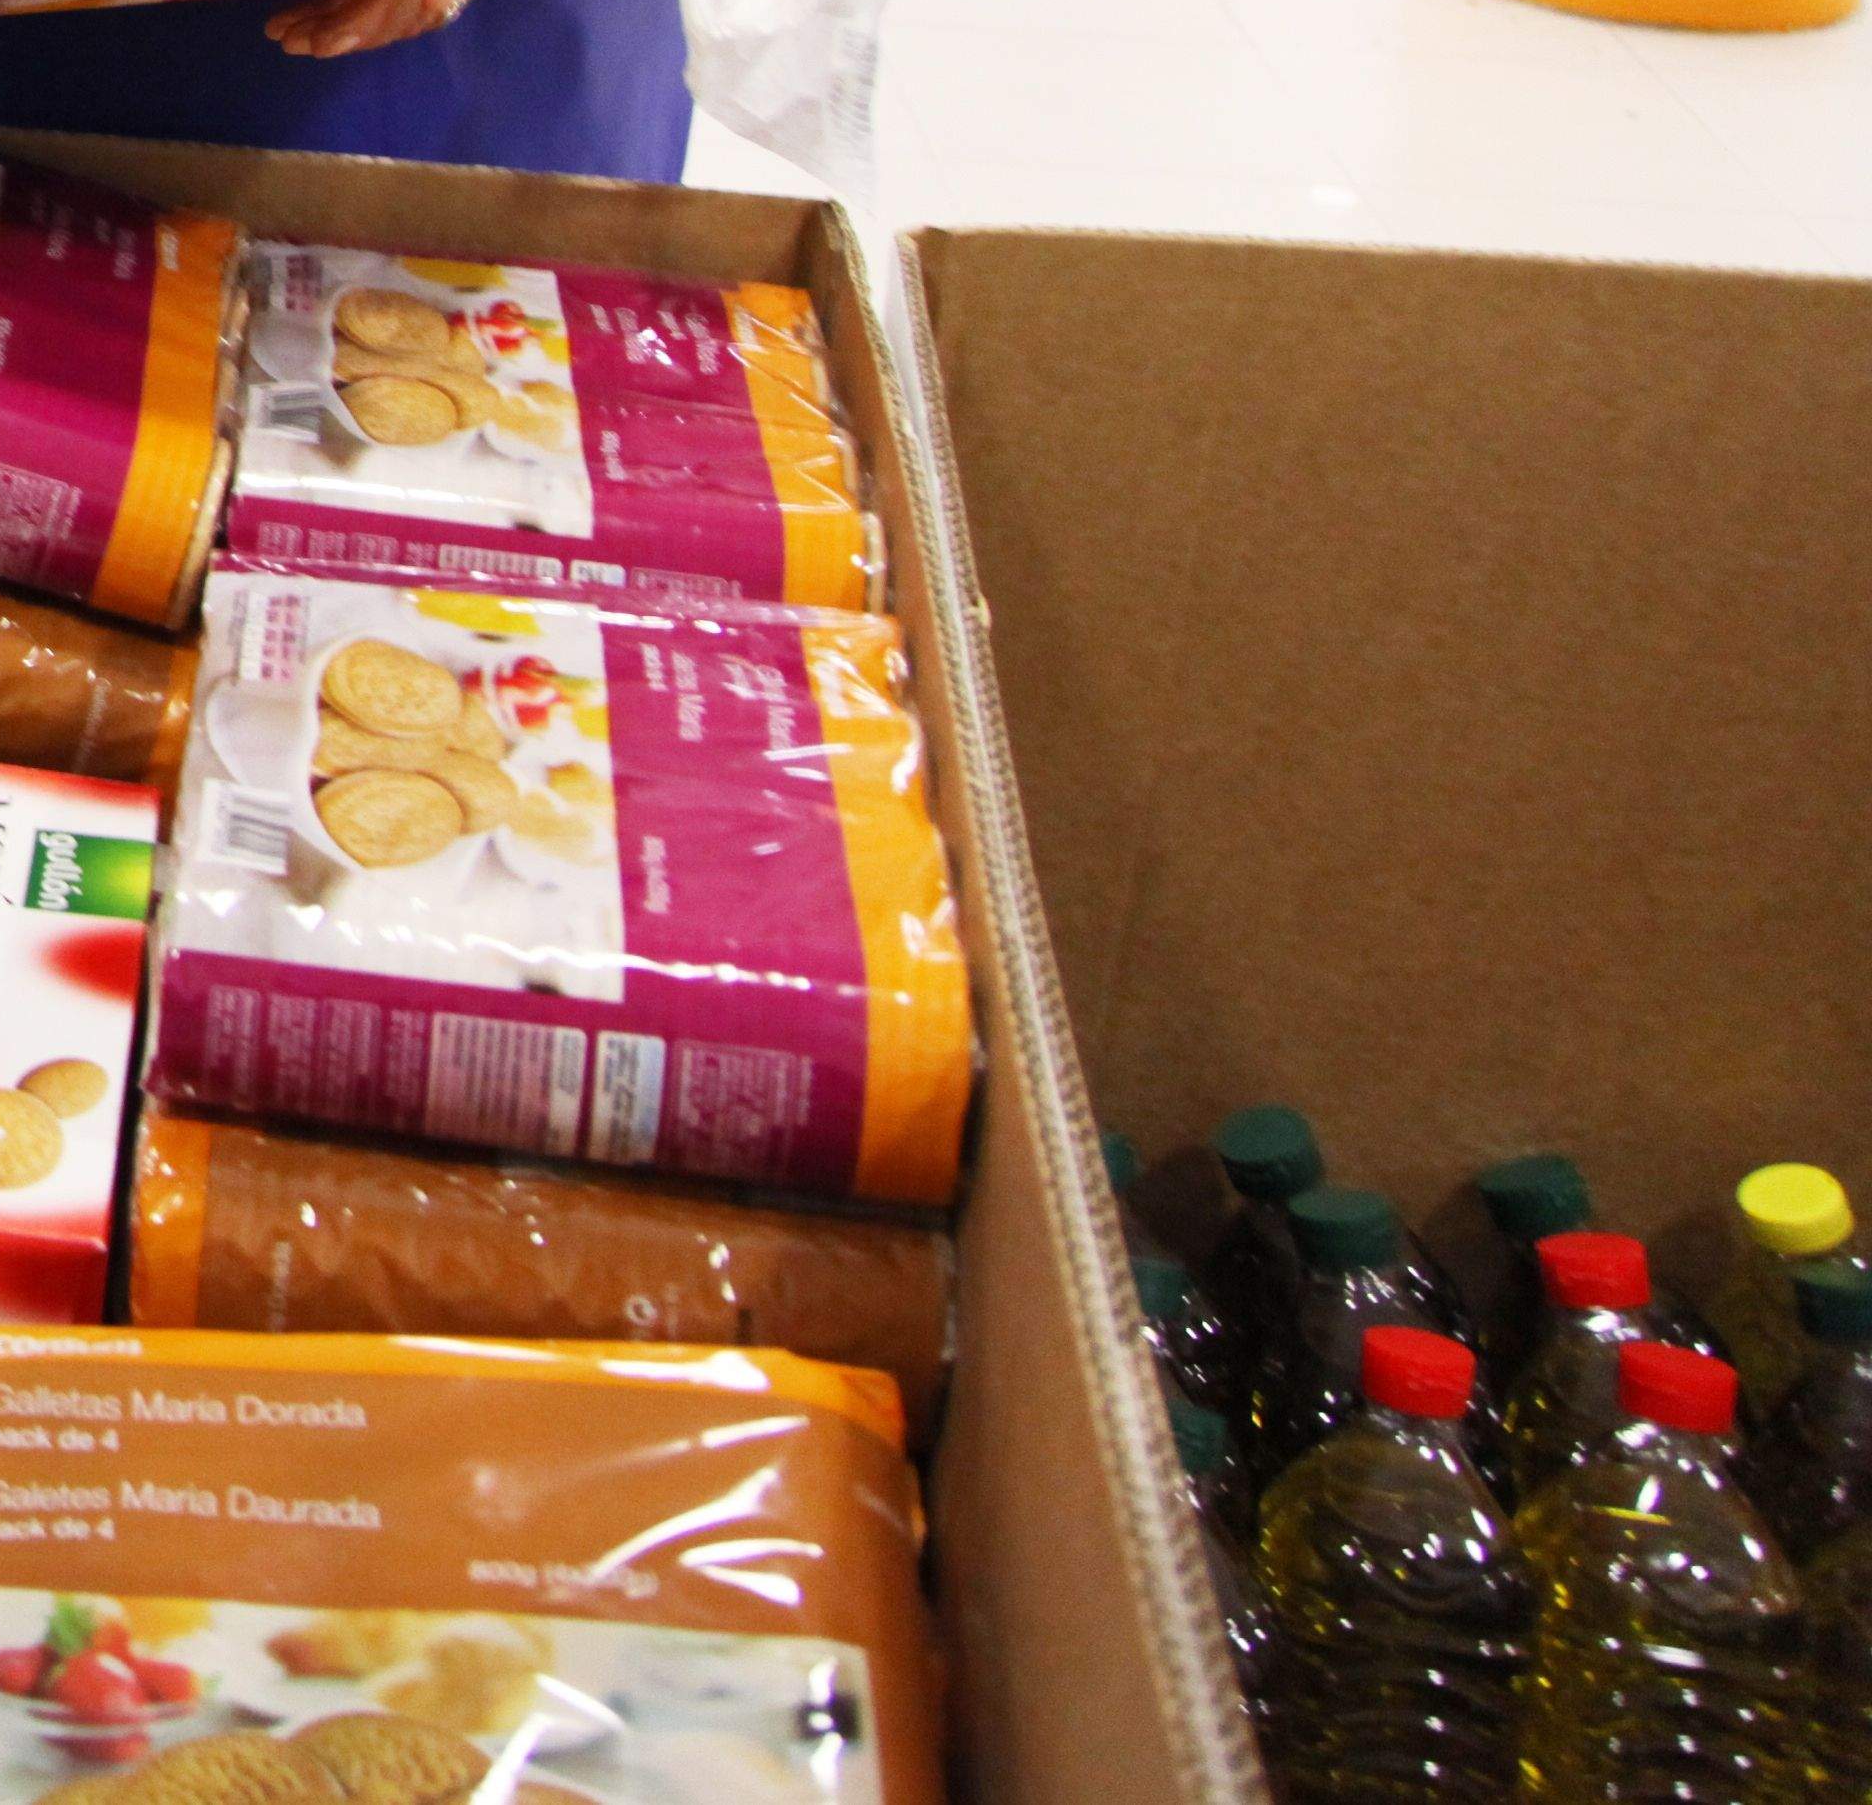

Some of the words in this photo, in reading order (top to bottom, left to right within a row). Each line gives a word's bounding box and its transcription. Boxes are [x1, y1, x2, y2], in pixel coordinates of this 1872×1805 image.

[38, 830, 86, 912] gullón
[235, 1392, 367, 1430] Dorada
[57, 1426, 95, 1452] de
[101, 1427, 121, 1452] 4
[226, 1485, 383, 1532] Daurada
[52, 1518, 92, 1541] de
